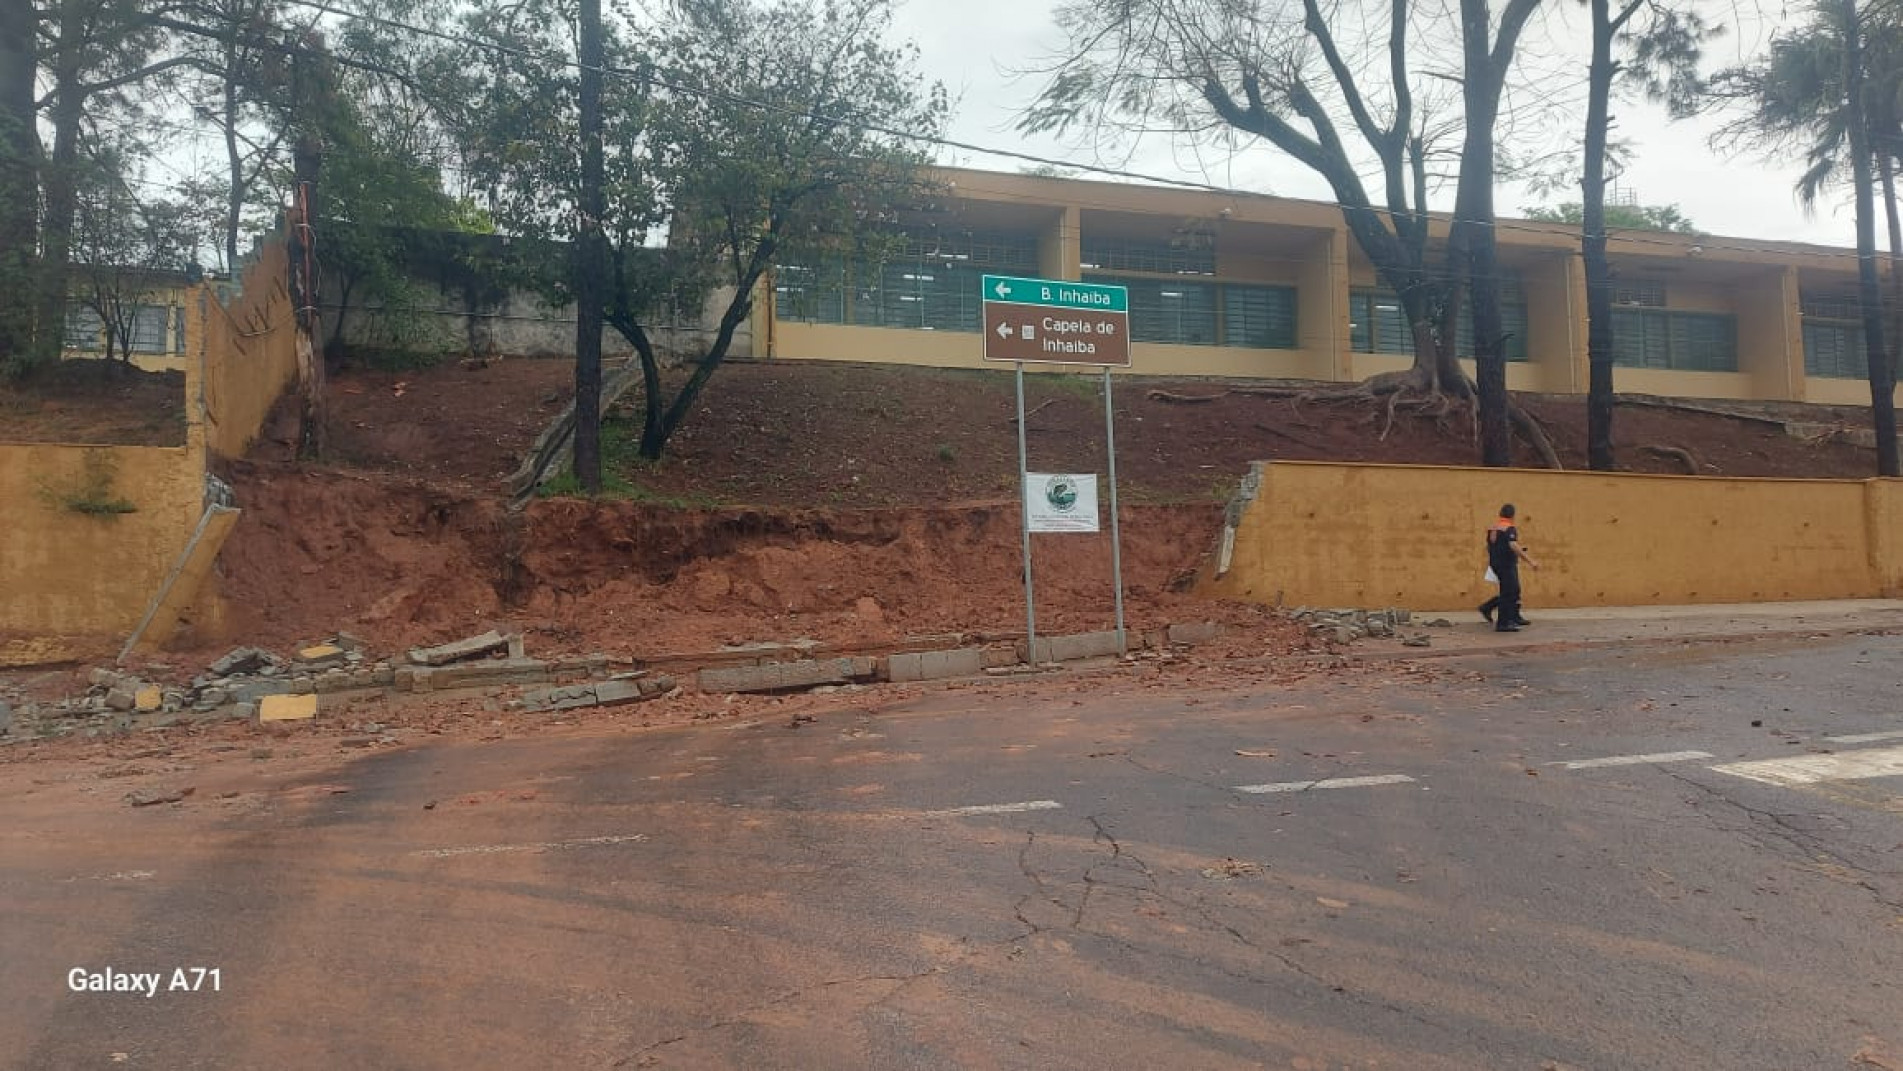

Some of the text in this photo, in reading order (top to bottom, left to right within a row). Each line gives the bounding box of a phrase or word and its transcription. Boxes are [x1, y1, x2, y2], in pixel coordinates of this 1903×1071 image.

[1041, 287, 1054, 301] B.
[1043, 317, 1114, 334] Capela de
